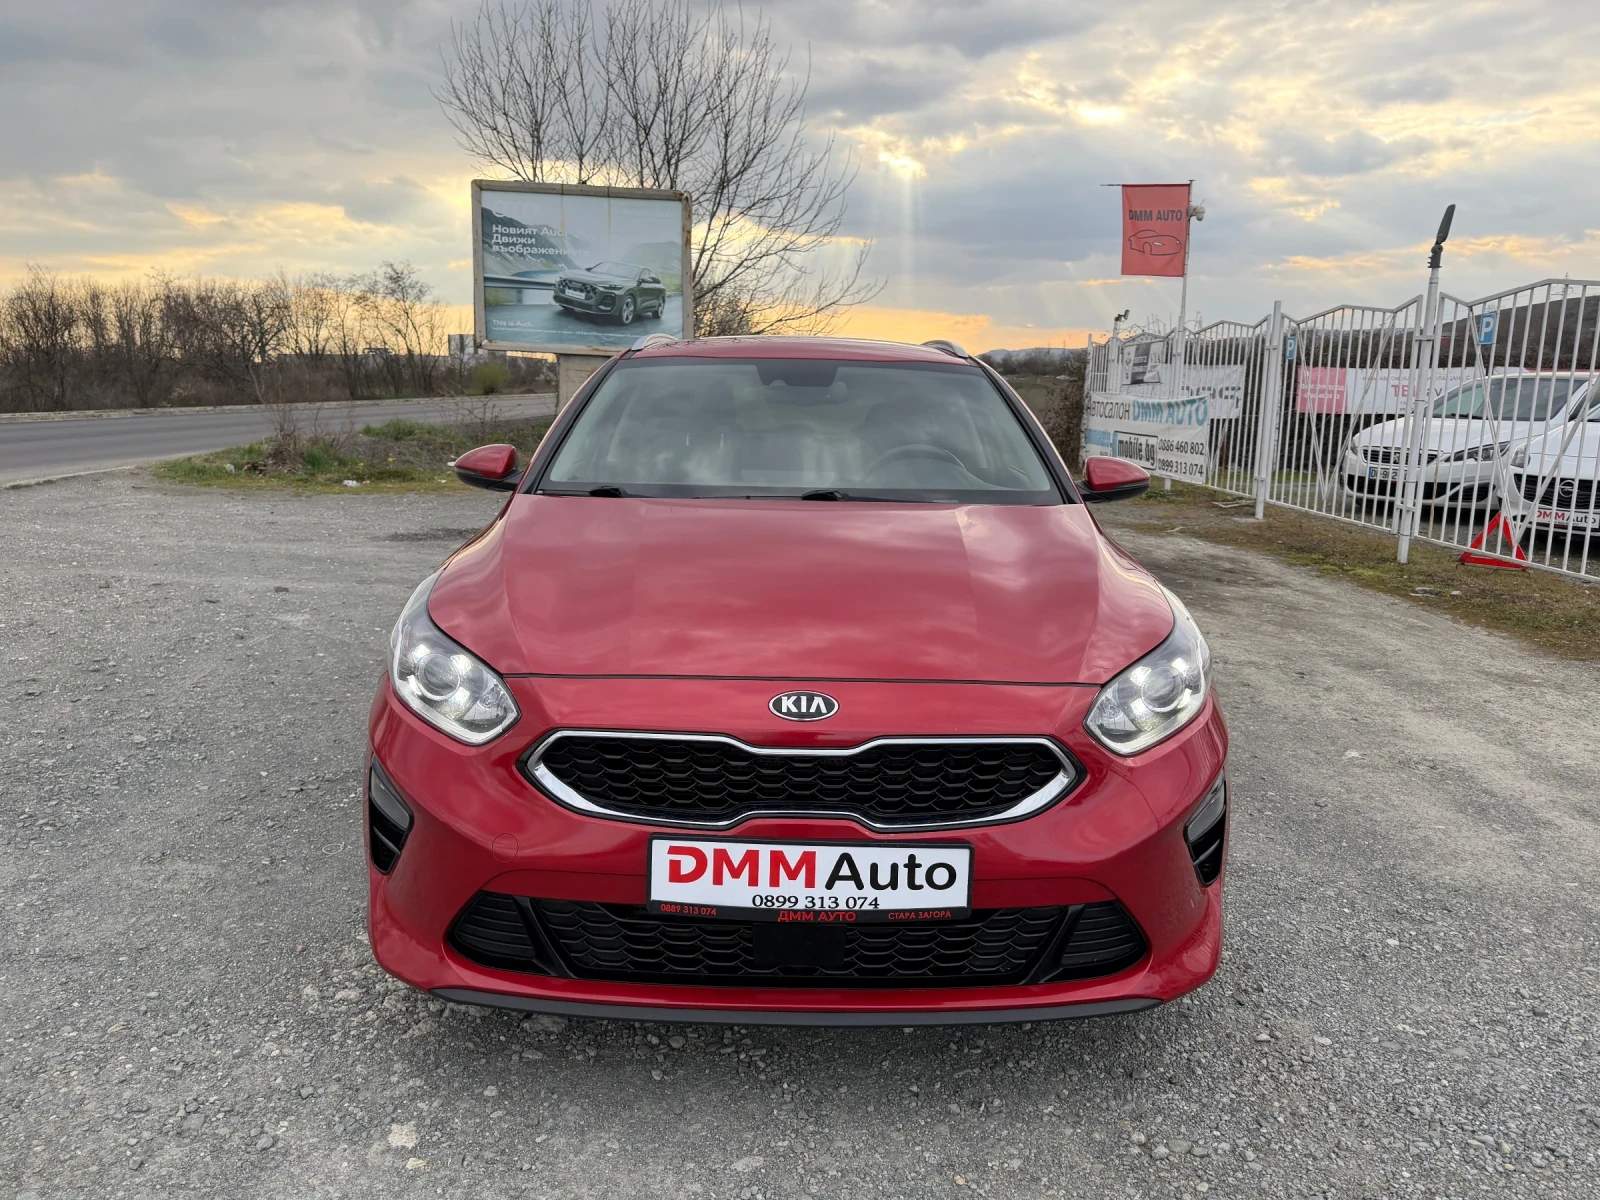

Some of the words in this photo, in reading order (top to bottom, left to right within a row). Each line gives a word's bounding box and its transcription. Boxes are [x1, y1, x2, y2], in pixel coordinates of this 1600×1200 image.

[1128, 209, 1153, 221] DMM
[1156, 209, 1183, 221] AUTO
[492, 224, 538, 235] Новият
[491, 233, 536, 245] Движи
[1480, 317, 1494, 341] P
[1086, 400, 1131, 420] Автосалон
[1132, 399, 1164, 423] DMM
[1165, 397, 1208, 426] AUTO
[1158, 439, 1174, 452] 0886
[1175, 440, 1188, 454] 460
[1189, 442, 1205, 455] 802
[1158, 458, 1174, 472] 0899
[1175, 460, 1188, 475] 313
[1188, 462, 1204, 477] 074
[781, 696, 827, 713] KIA
[752, 894, 798, 908] 0899
[804, 896, 840, 909] 313
[845, 896, 880, 909] 074
[660, 903, 681, 913] 0889
[683, 905, 699, 915] 313
[701, 907, 717, 916] 074
[777, 910, 814, 922] ДММ
[818, 911, 857, 921] АУТО
[888, 912, 916, 920] СТАРА
[918, 910, 952, 919] ЗАГОРА
